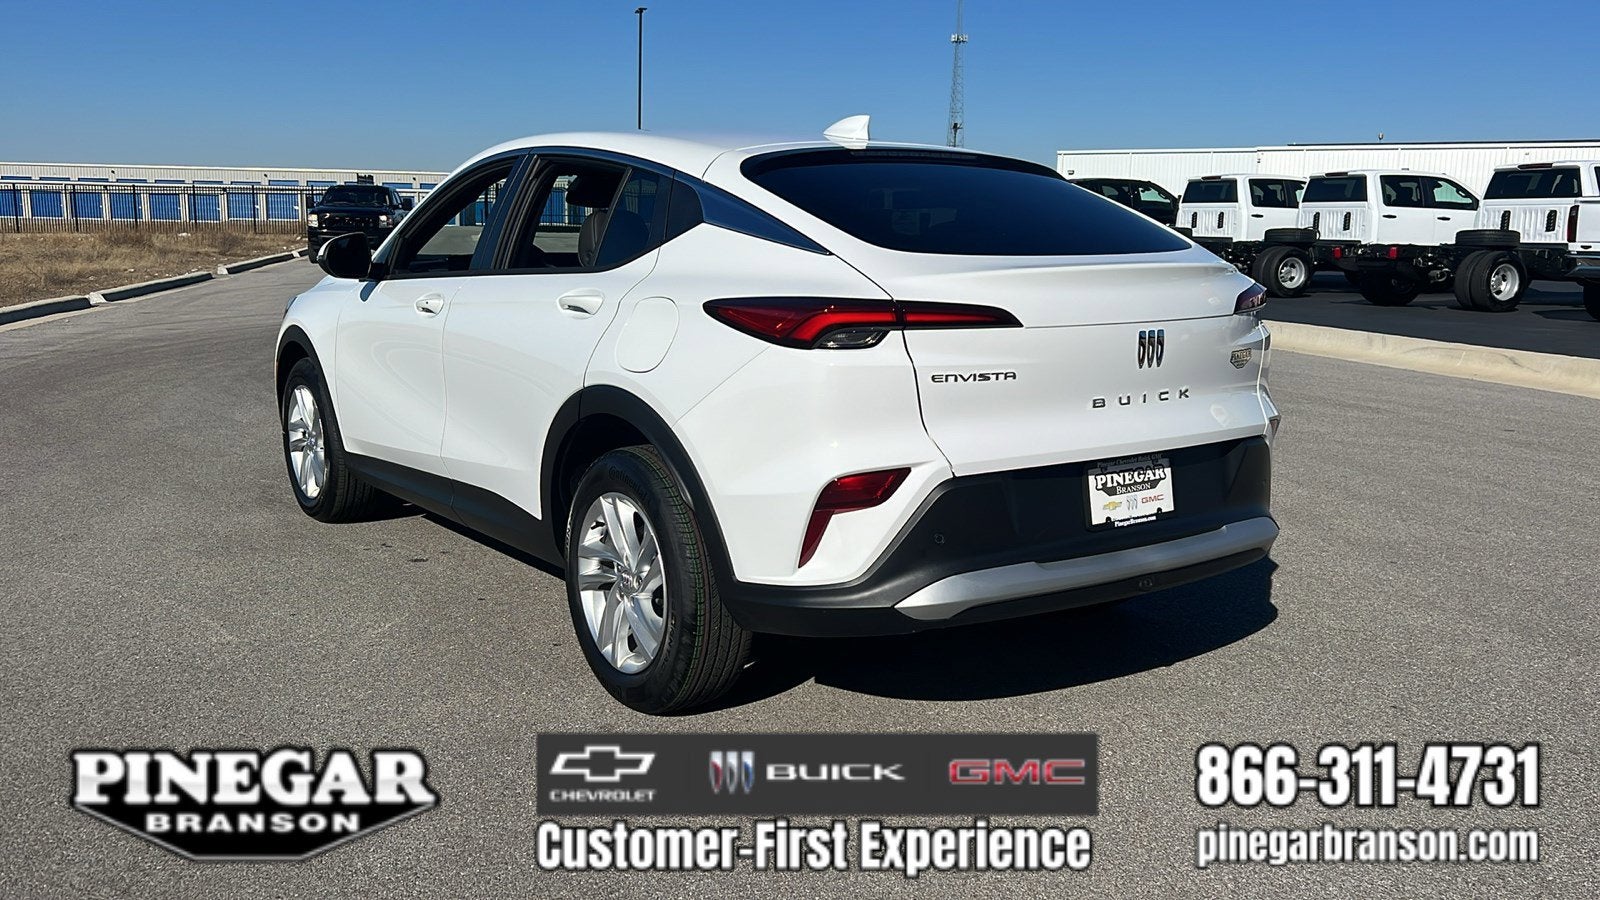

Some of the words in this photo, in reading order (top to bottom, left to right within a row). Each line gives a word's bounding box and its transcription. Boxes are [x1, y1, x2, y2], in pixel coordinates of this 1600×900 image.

[931, 371, 1017, 383] ENVISTA
[1092, 387, 1190, 408] BUICK
[1095, 467, 1166, 490] PINEGAR
[1141, 494, 1164, 504] GMC
